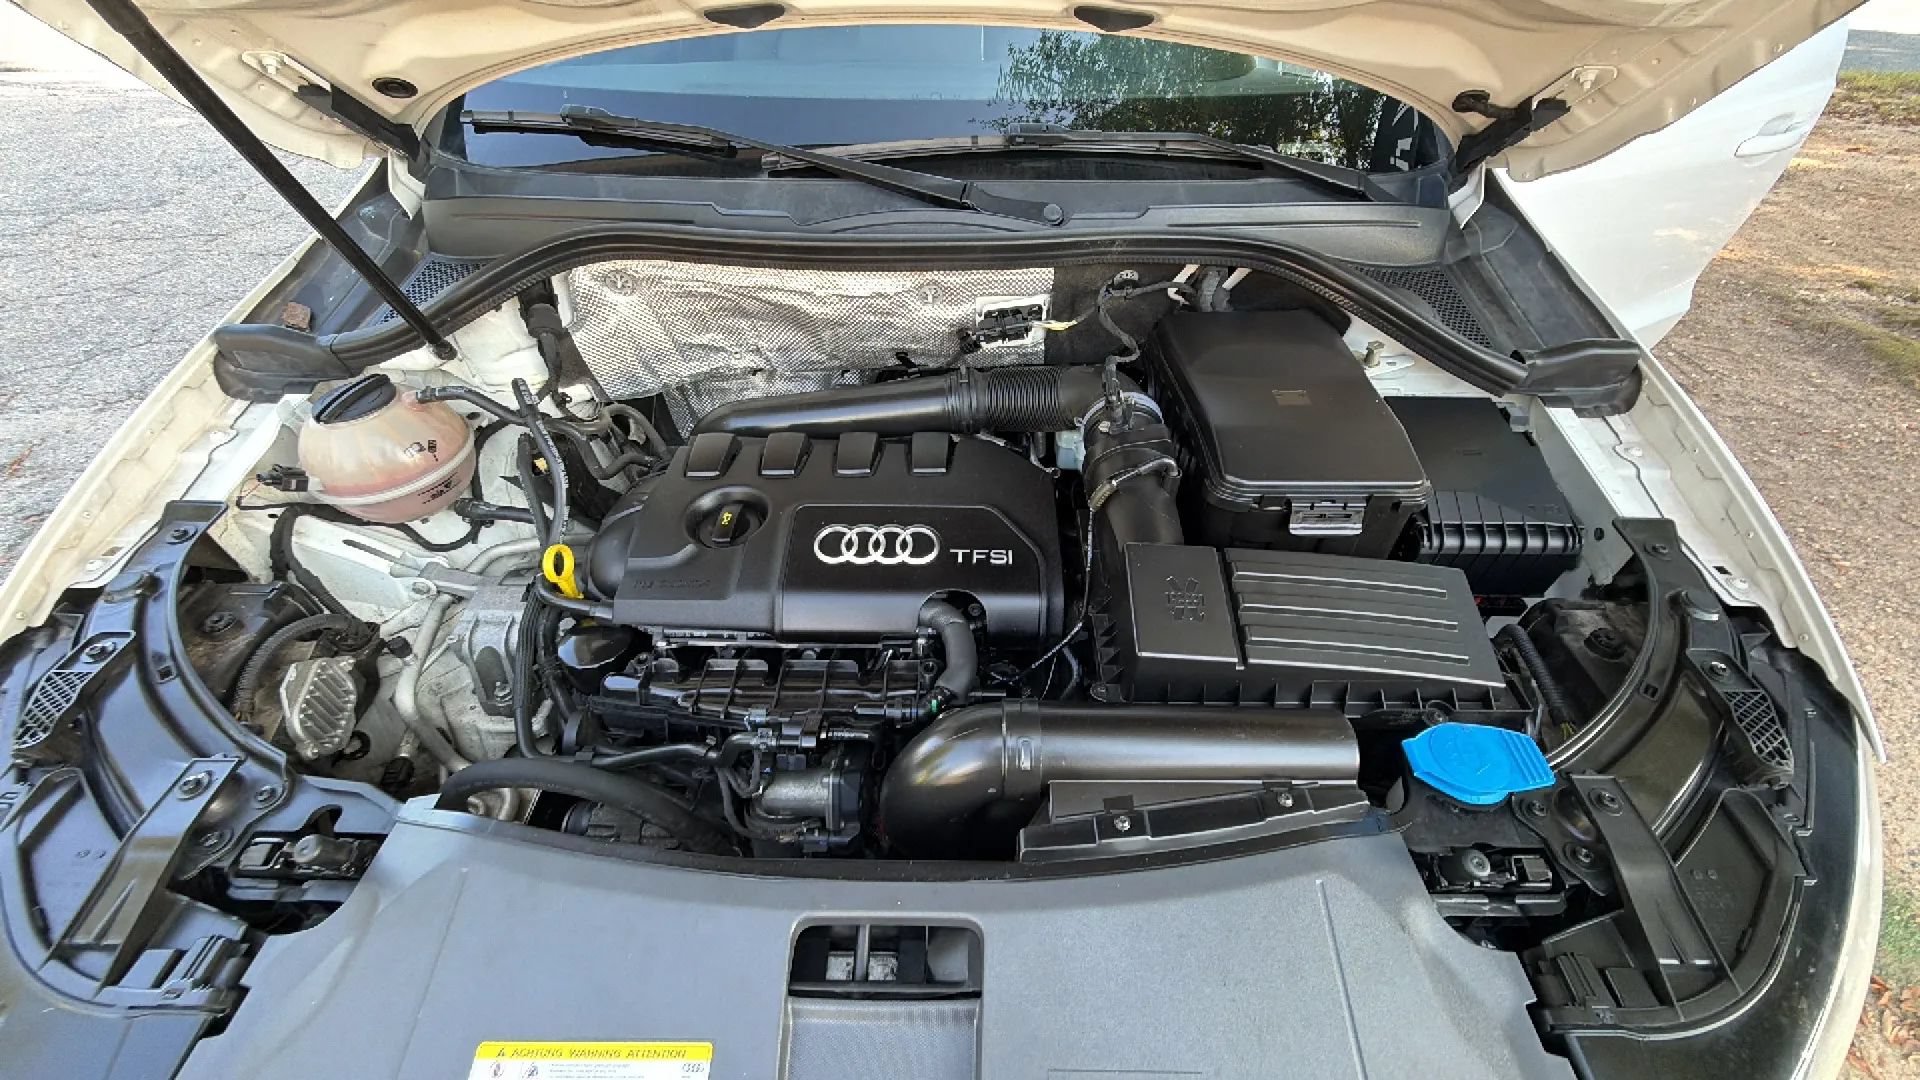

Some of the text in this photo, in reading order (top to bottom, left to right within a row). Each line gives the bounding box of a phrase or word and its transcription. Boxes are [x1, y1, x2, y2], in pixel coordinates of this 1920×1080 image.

[949, 549, 1013, 565] TFSI
[511, 1048, 687, 1058] ACHTUNG WARNING ATTENTION
